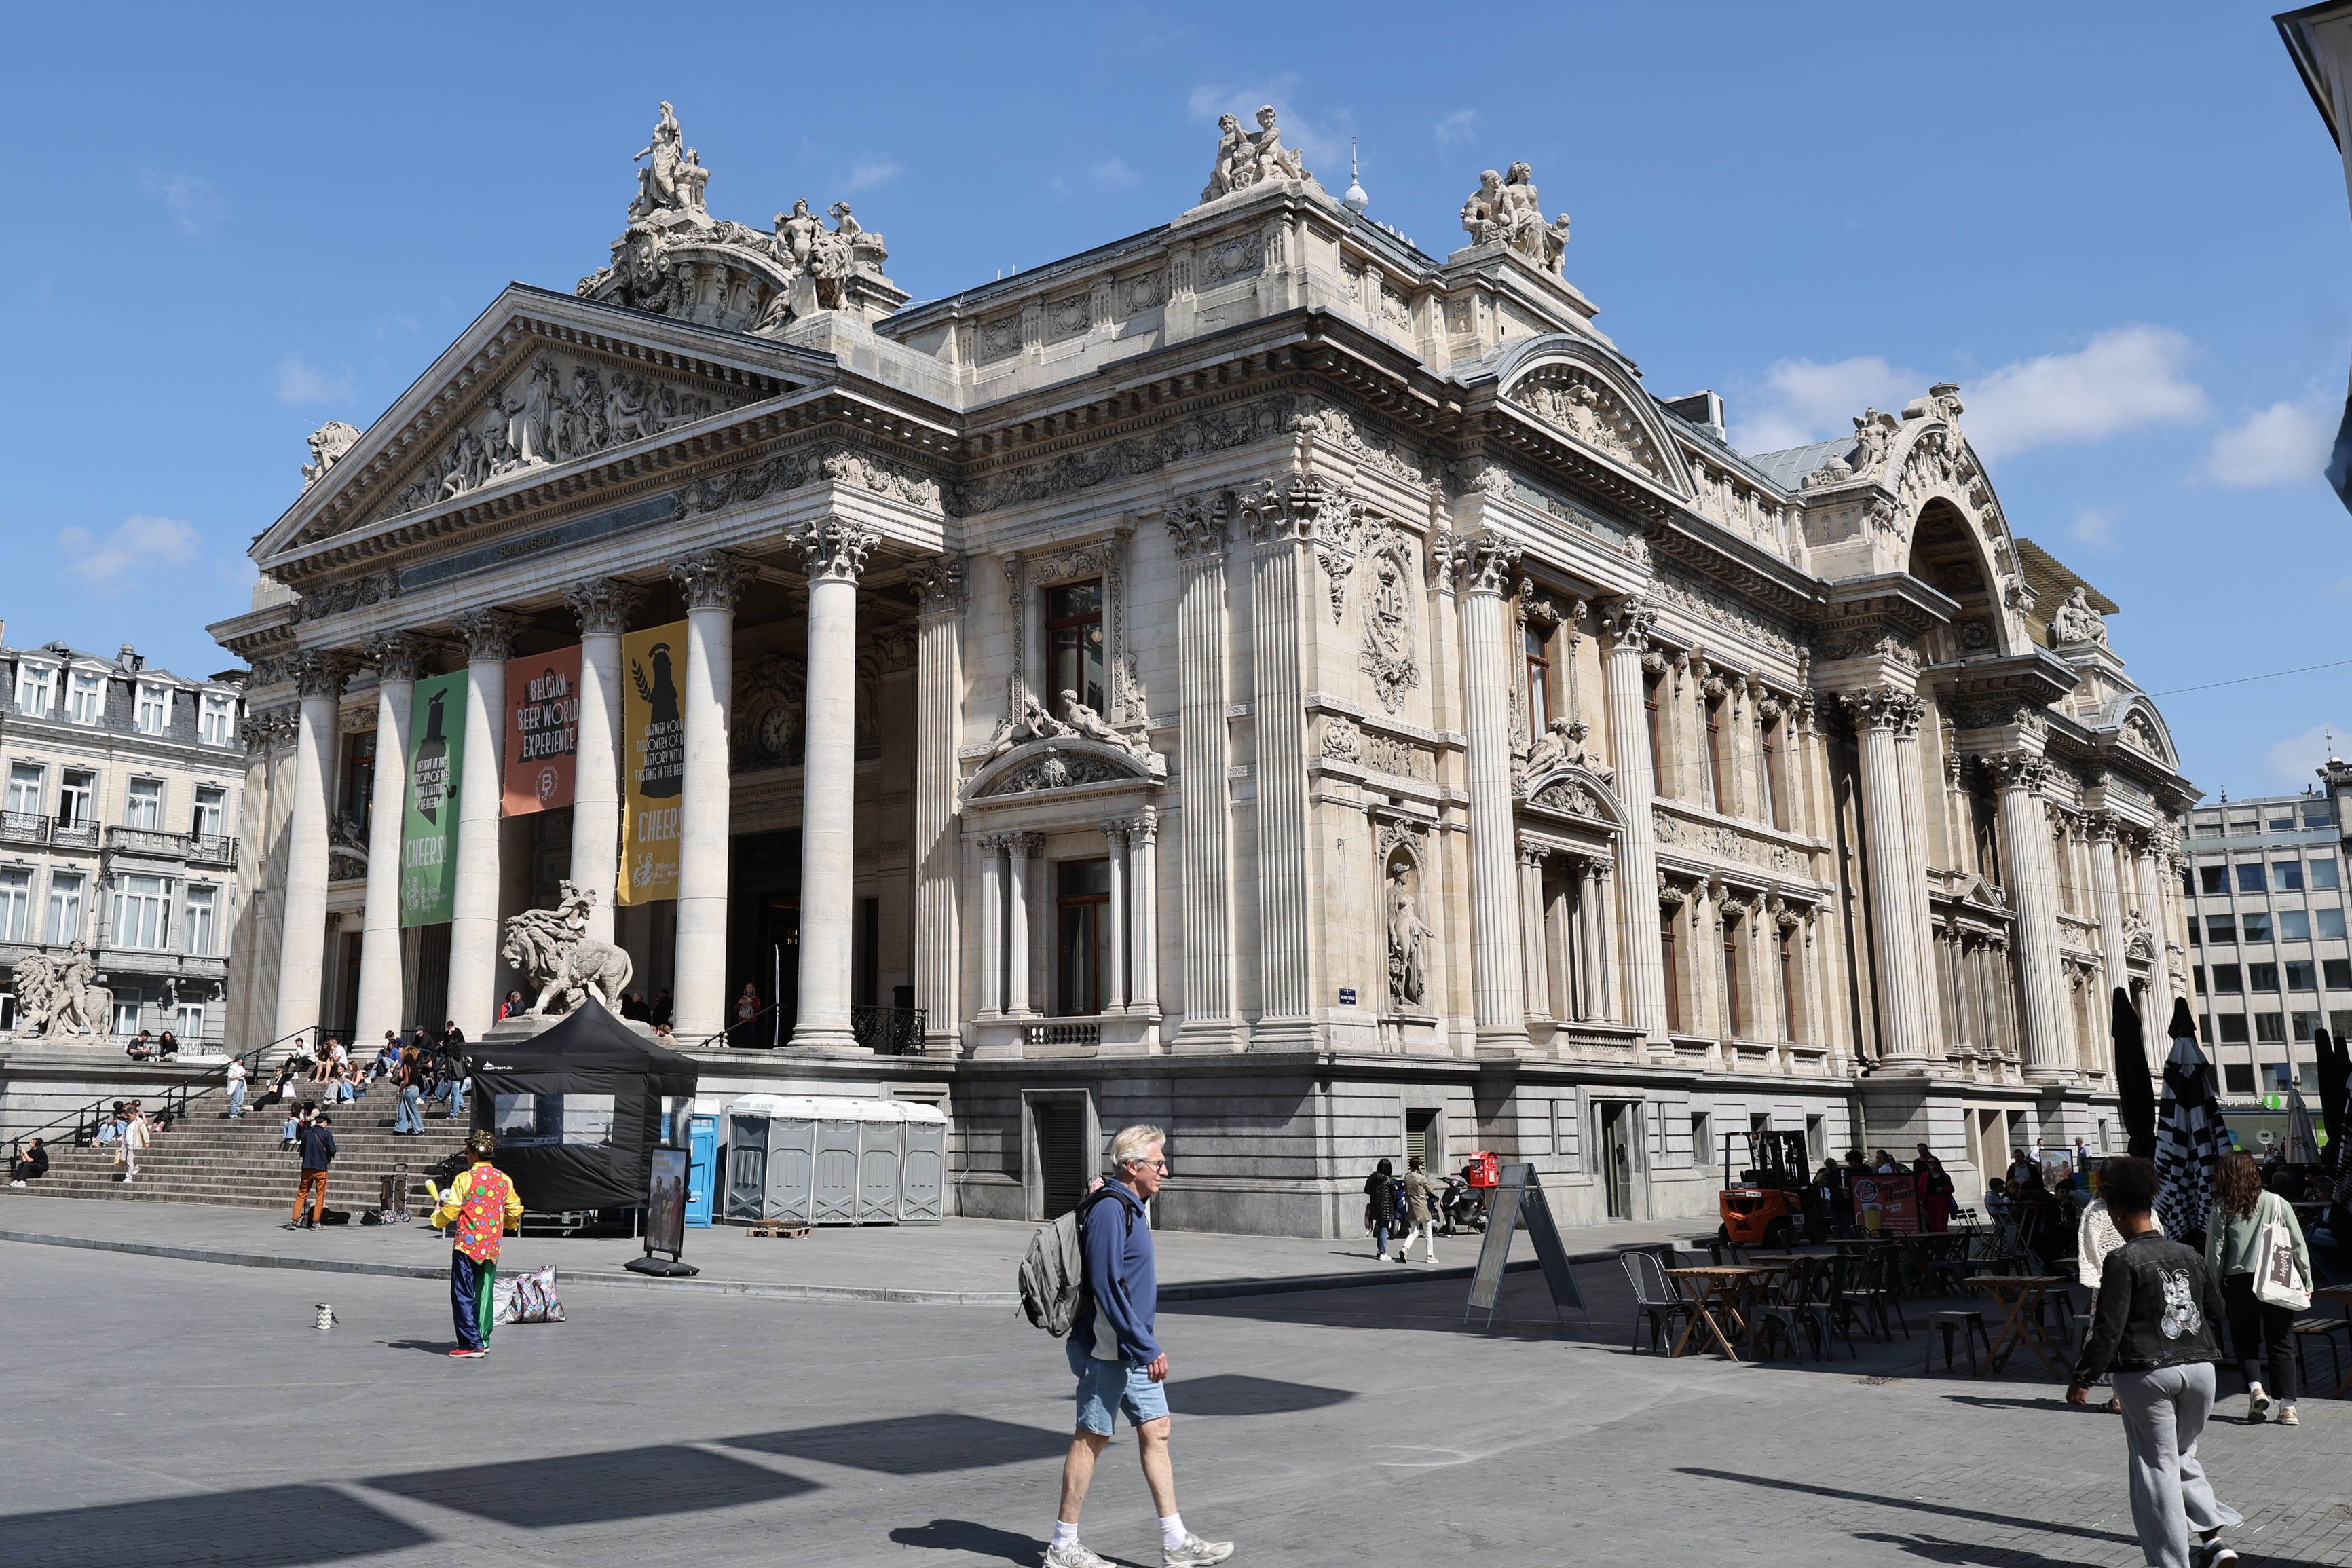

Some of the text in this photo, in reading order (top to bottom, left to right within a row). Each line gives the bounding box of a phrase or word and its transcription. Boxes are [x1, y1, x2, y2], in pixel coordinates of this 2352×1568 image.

[500, 534, 557, 557] BourseBeurs
[517, 698, 578, 731] BEER WORLD
[667, 719, 683, 733] YOUR
[669, 734, 679, 747] OF
[438, 756, 447, 768] THE
[430, 770, 440, 782] OF
[663, 764, 672, 778] THE
[424, 785, 428, 796] A
[418, 798, 426, 810] THE
[406, 835, 448, 868] CHEERS!
[656, 863, 676, 872] Belgian
